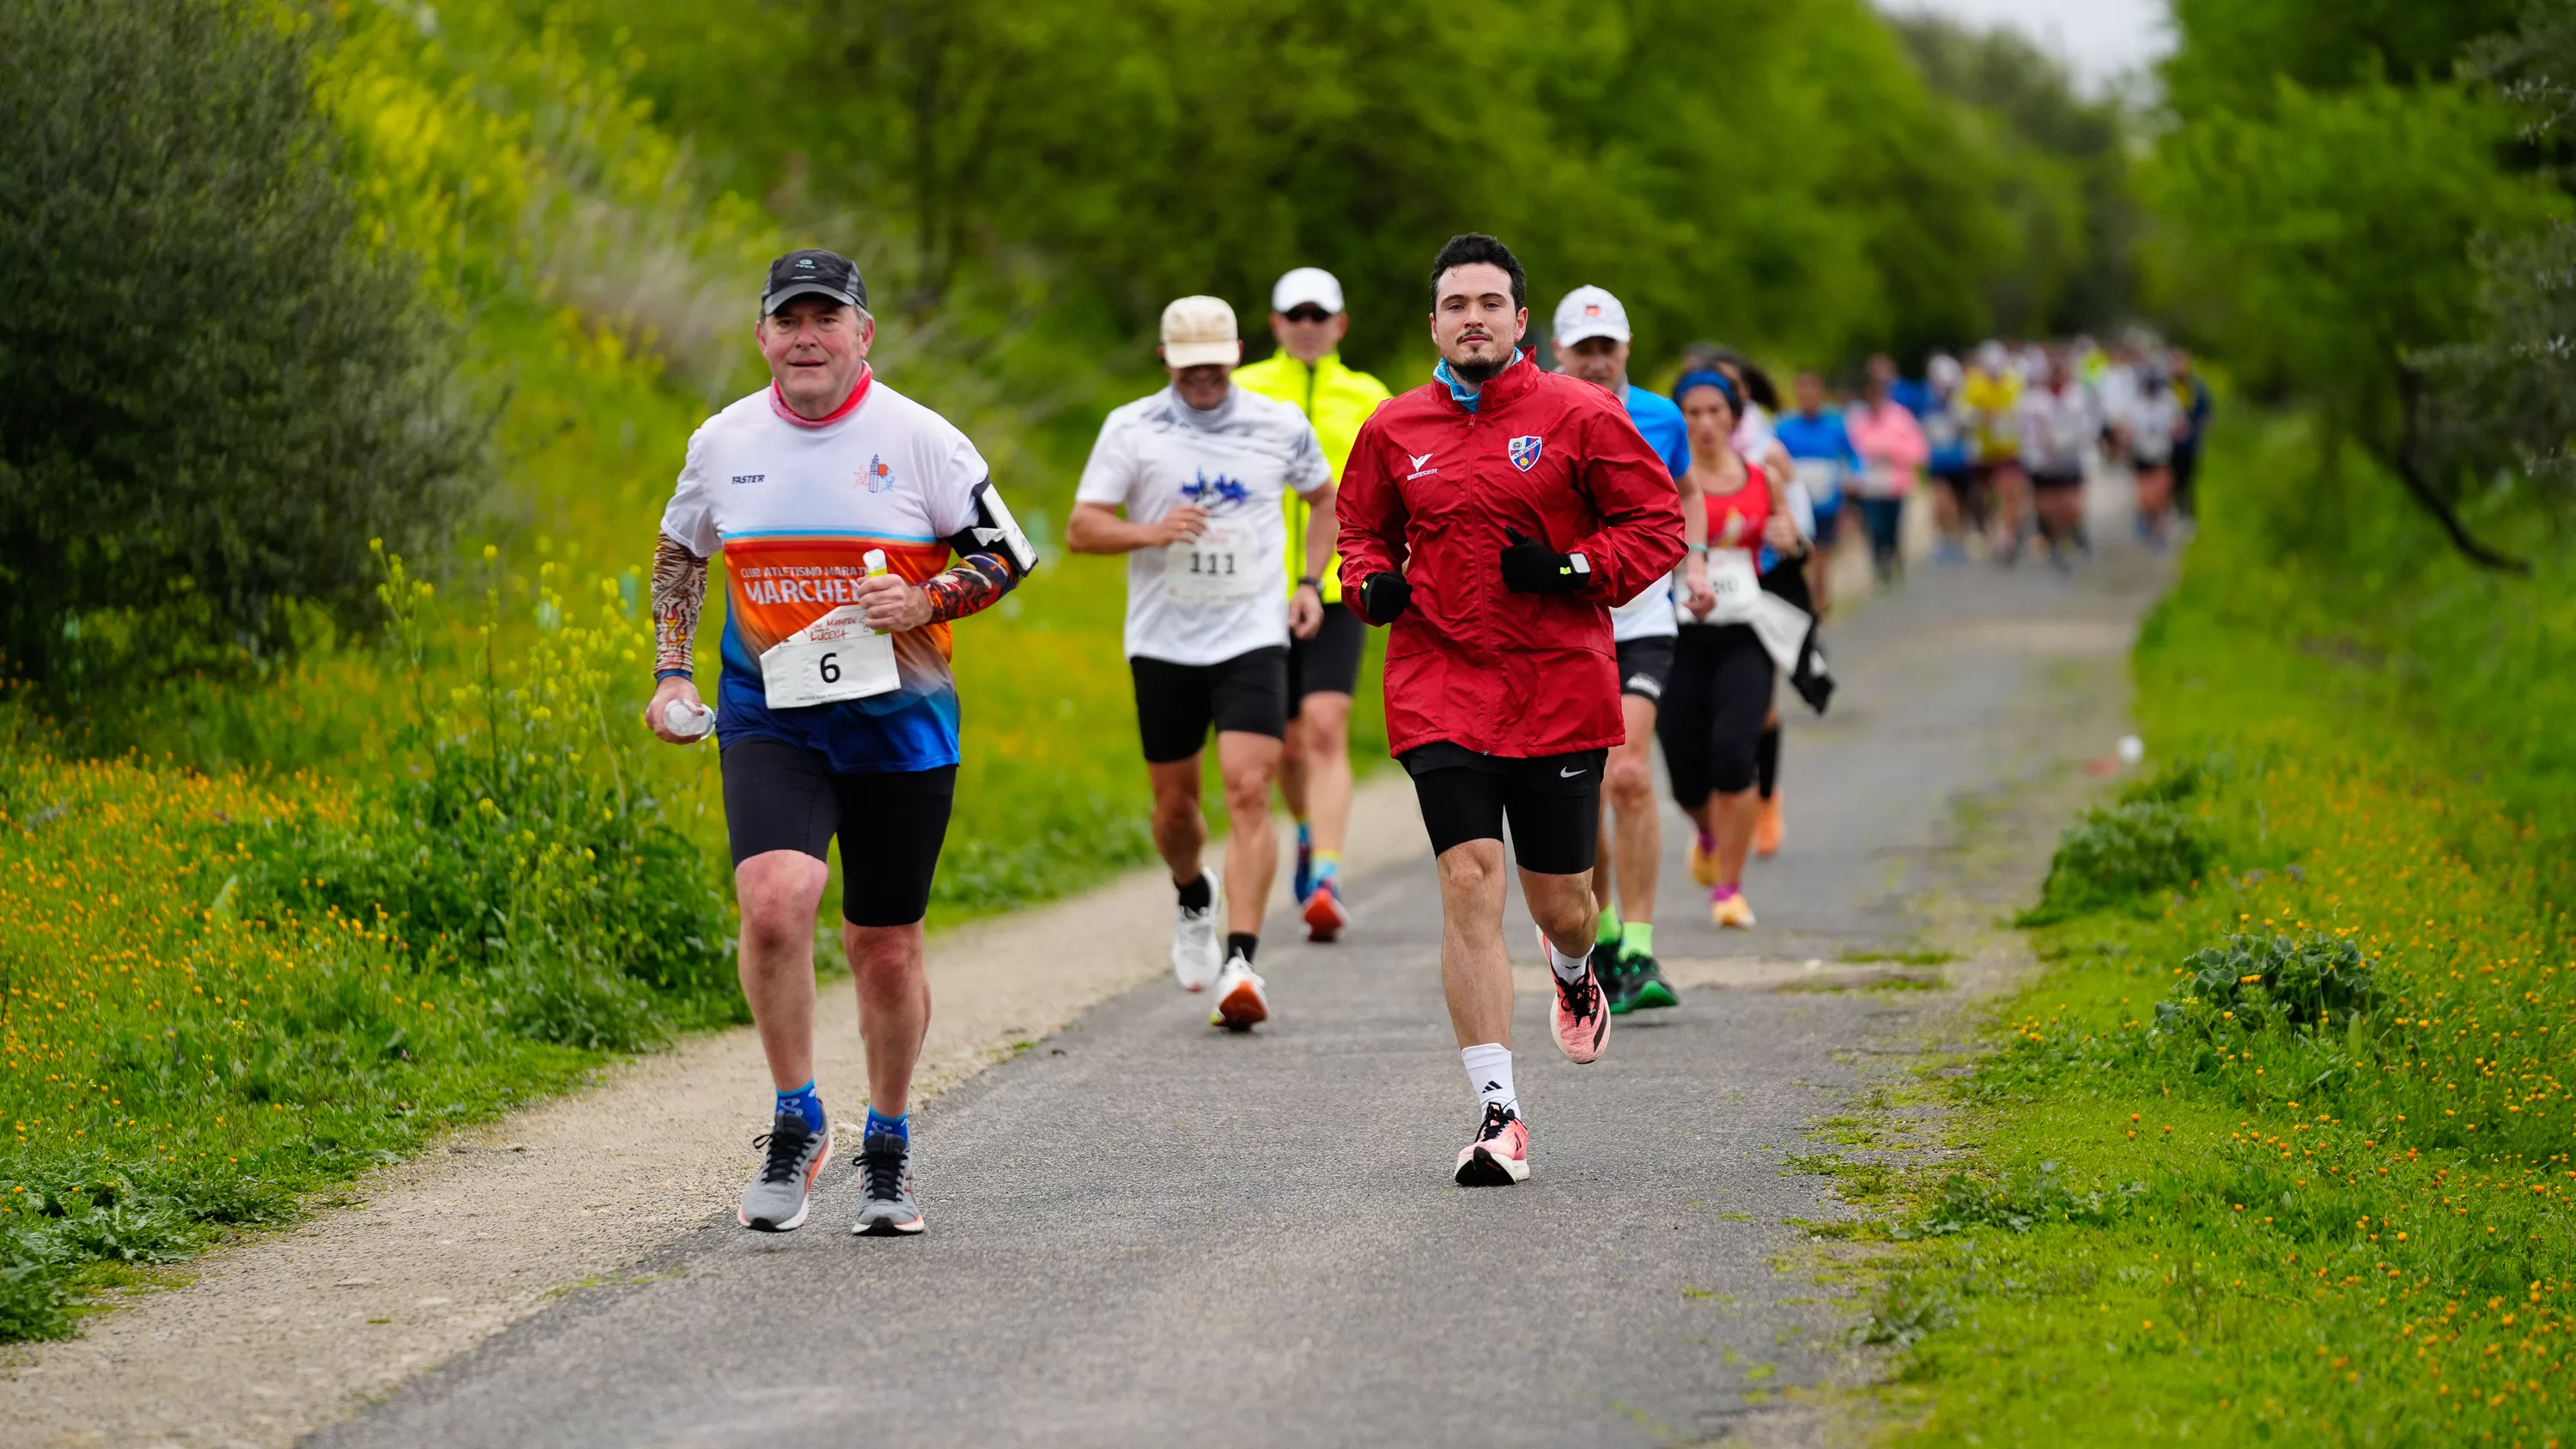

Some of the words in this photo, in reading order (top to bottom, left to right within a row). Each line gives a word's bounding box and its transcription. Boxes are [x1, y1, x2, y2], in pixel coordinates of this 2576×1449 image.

[732, 474, 765, 485] FASTER
[1188, 552, 1236, 575] 111
[740, 567, 762, 578] CLUB
[763, 567, 822, 577] ATLETISMO
[810, 628, 851, 642] LUCENA
[820, 652, 841, 683] 6
